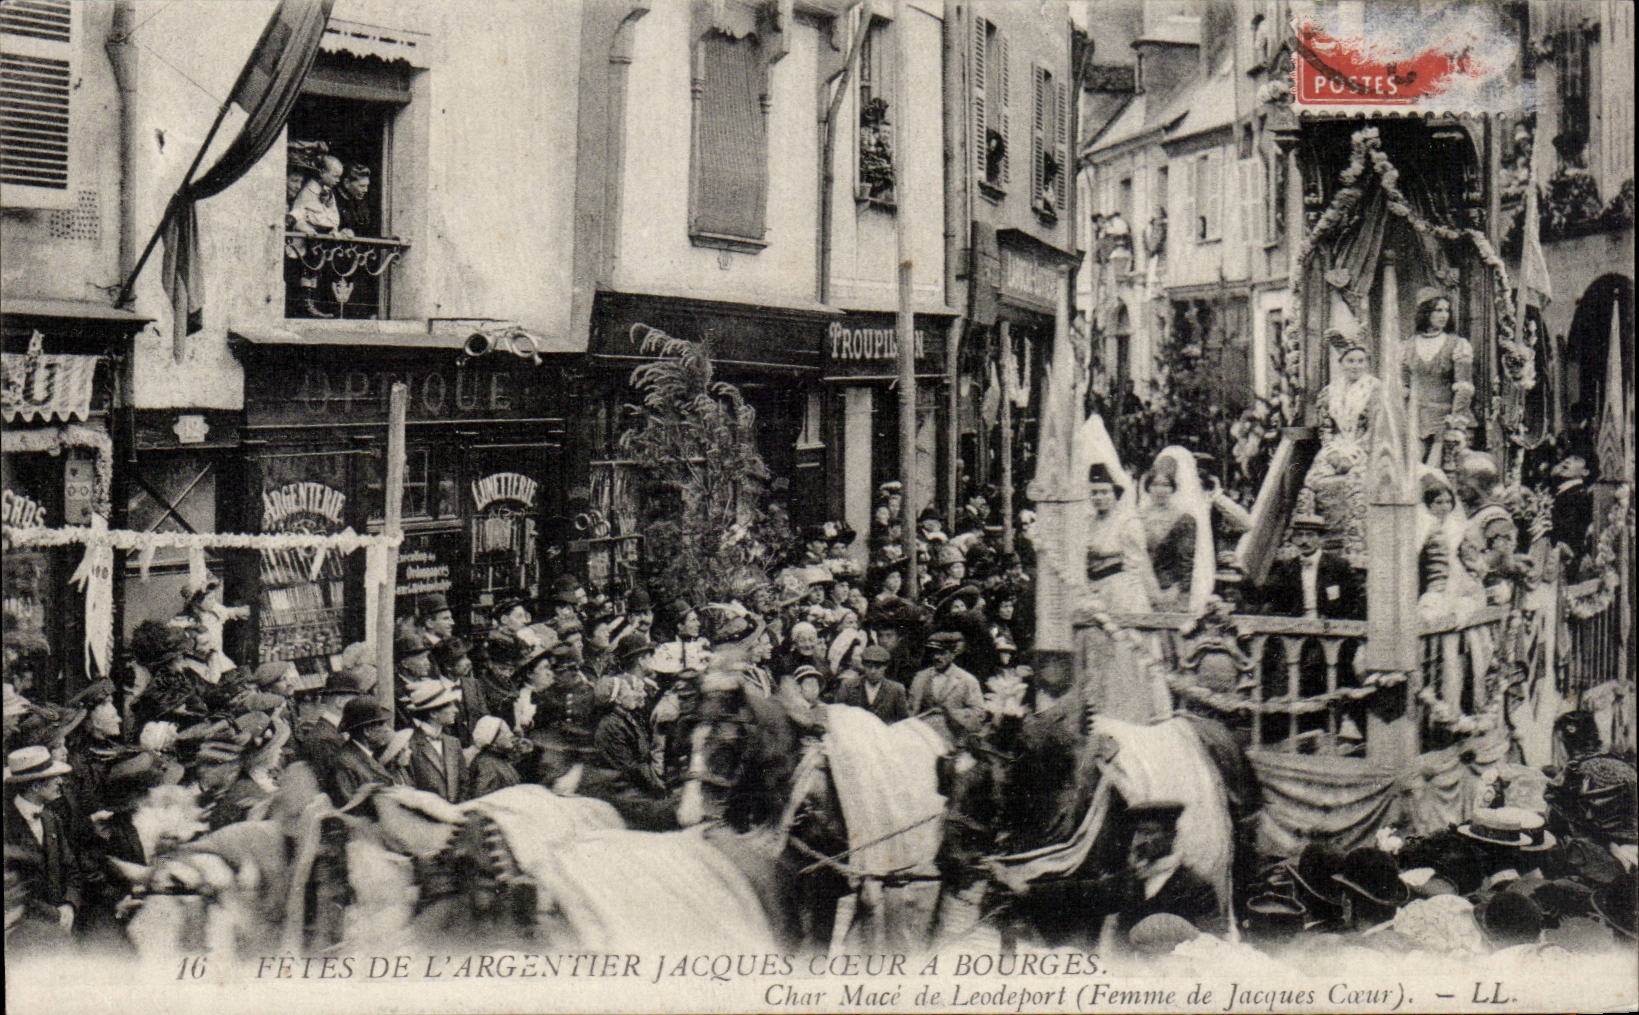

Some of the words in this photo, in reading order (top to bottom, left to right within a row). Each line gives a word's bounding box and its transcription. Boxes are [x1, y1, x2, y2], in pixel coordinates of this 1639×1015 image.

[1313, 75, 1398, 96] POSTES
[300, 371, 512, 418] OPTIQUE
[262, 482, 346, 526] ARGENTERIE
[473, 472, 539, 511] LUNETTERIE
